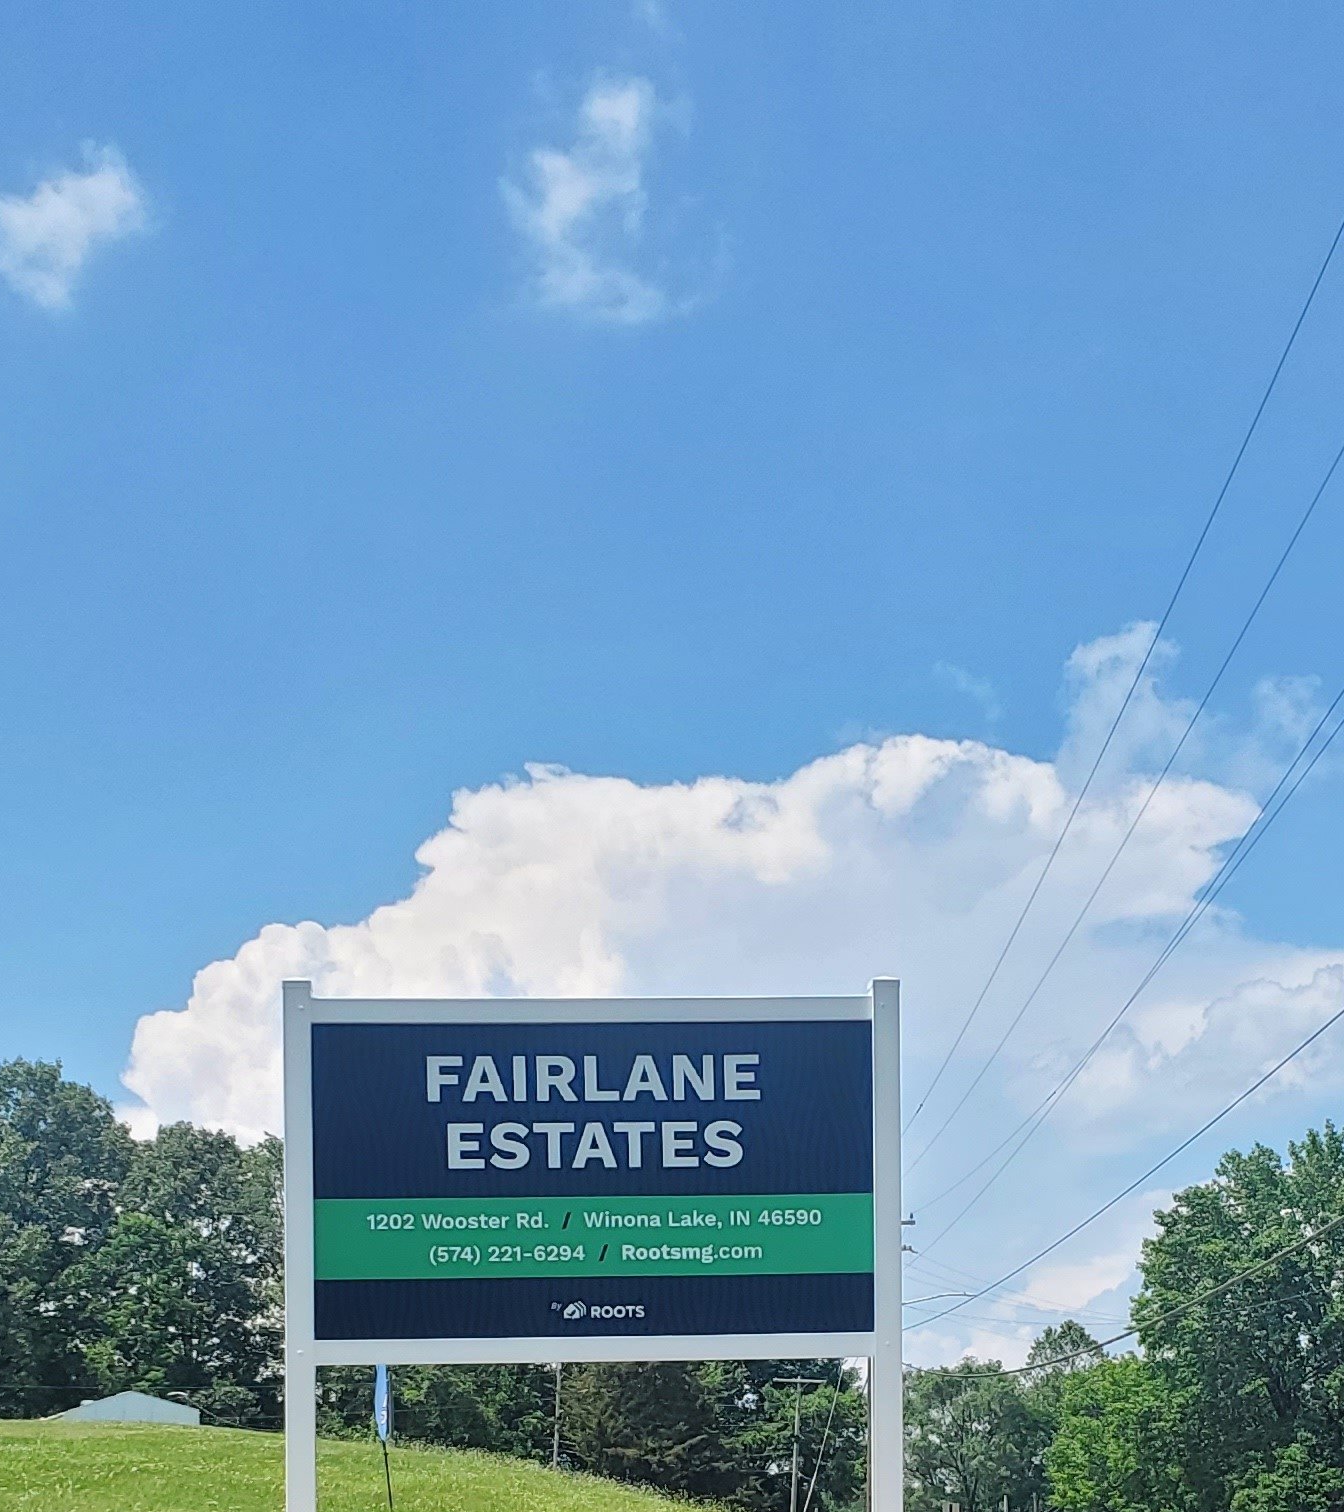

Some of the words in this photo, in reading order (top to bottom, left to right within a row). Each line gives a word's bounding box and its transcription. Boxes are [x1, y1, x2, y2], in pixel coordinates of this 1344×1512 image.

[426, 1054, 761, 1102] FAIRLANE
[447, 1120, 744, 1169] ESTATES
[366, 1214, 415, 1230] 1202
[422, 1213, 509, 1229] Wooster
[516, 1211, 549, 1229] Rd.
[584, 1210, 661, 1228] Winona
[668, 1209, 723, 1229] Lake,
[730, 1210, 751, 1226] IN
[758, 1209, 822, 1226] 46590
[429, 1245, 481, 1266] (574)
[488, 1245, 585, 1262] 221-6294
[622, 1244, 763, 1264] Rootsmg.com
[551, 1302, 562, 1311] By
[590, 1305, 645, 1319] ROOTS
